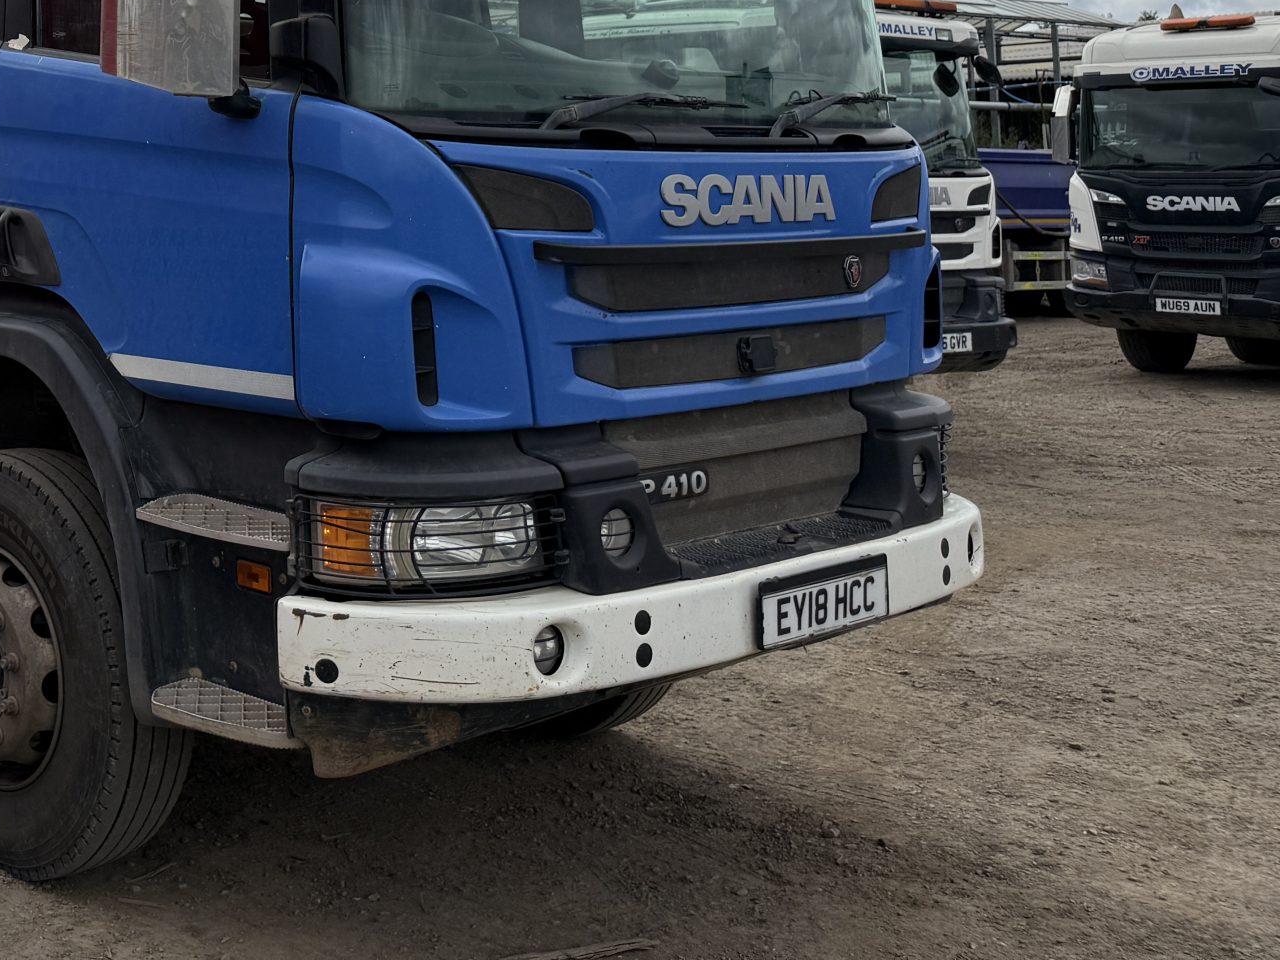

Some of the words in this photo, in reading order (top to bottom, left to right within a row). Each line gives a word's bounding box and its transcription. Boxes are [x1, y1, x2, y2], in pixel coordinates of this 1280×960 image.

[878, 23, 934, 37] MALLEY
[660, 173, 836, 227] SCANIA
[1145, 195, 1241, 212] SCANIA
[1160, 299, 1190, 311] WU69
[1193, 301, 1216, 313] AUN
[950, 334, 967, 349] GVR
[660, 470, 707, 498] 410
[777, 588, 828, 637] EY18
[835, 575, 875, 621] HCC
